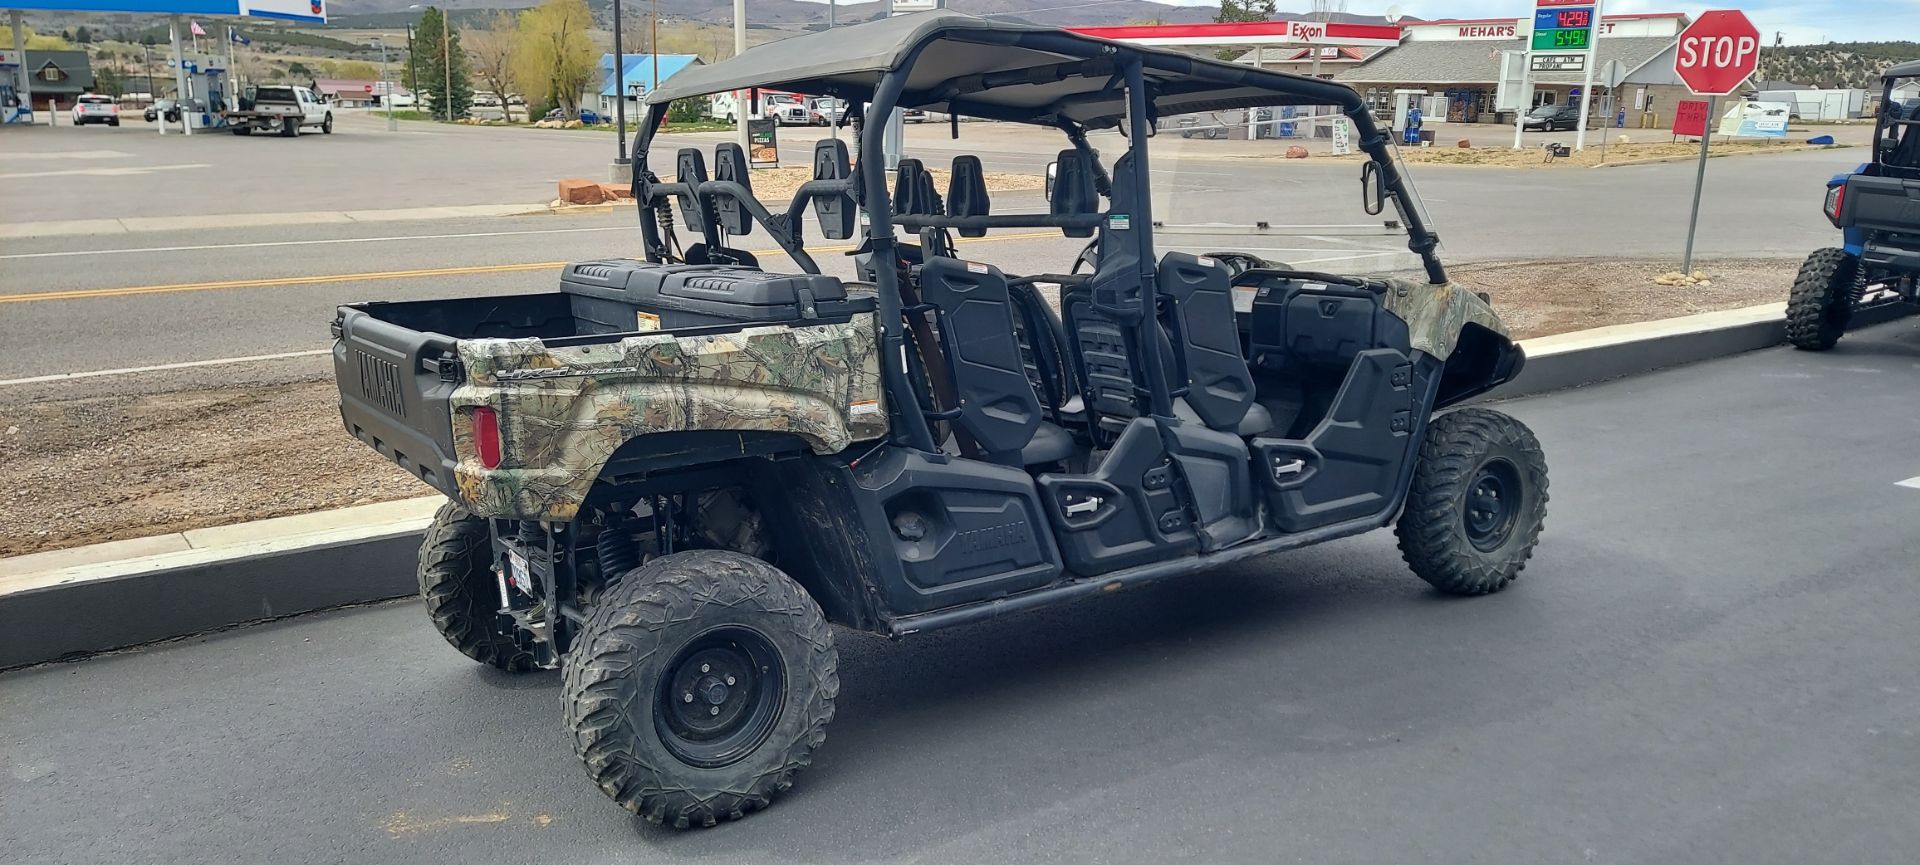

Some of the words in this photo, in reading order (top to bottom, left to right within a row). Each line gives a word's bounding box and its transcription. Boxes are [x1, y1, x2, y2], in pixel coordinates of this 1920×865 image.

[1292, 23, 1322, 41] Exxon
[1459, 25, 1515, 37] MEHAR'S
[1680, 35, 1755, 68] STOP
[1681, 102, 1706, 111] DRIV
[355, 349, 406, 418] YAMAHA
[958, 521, 1026, 554] YAMAHA
